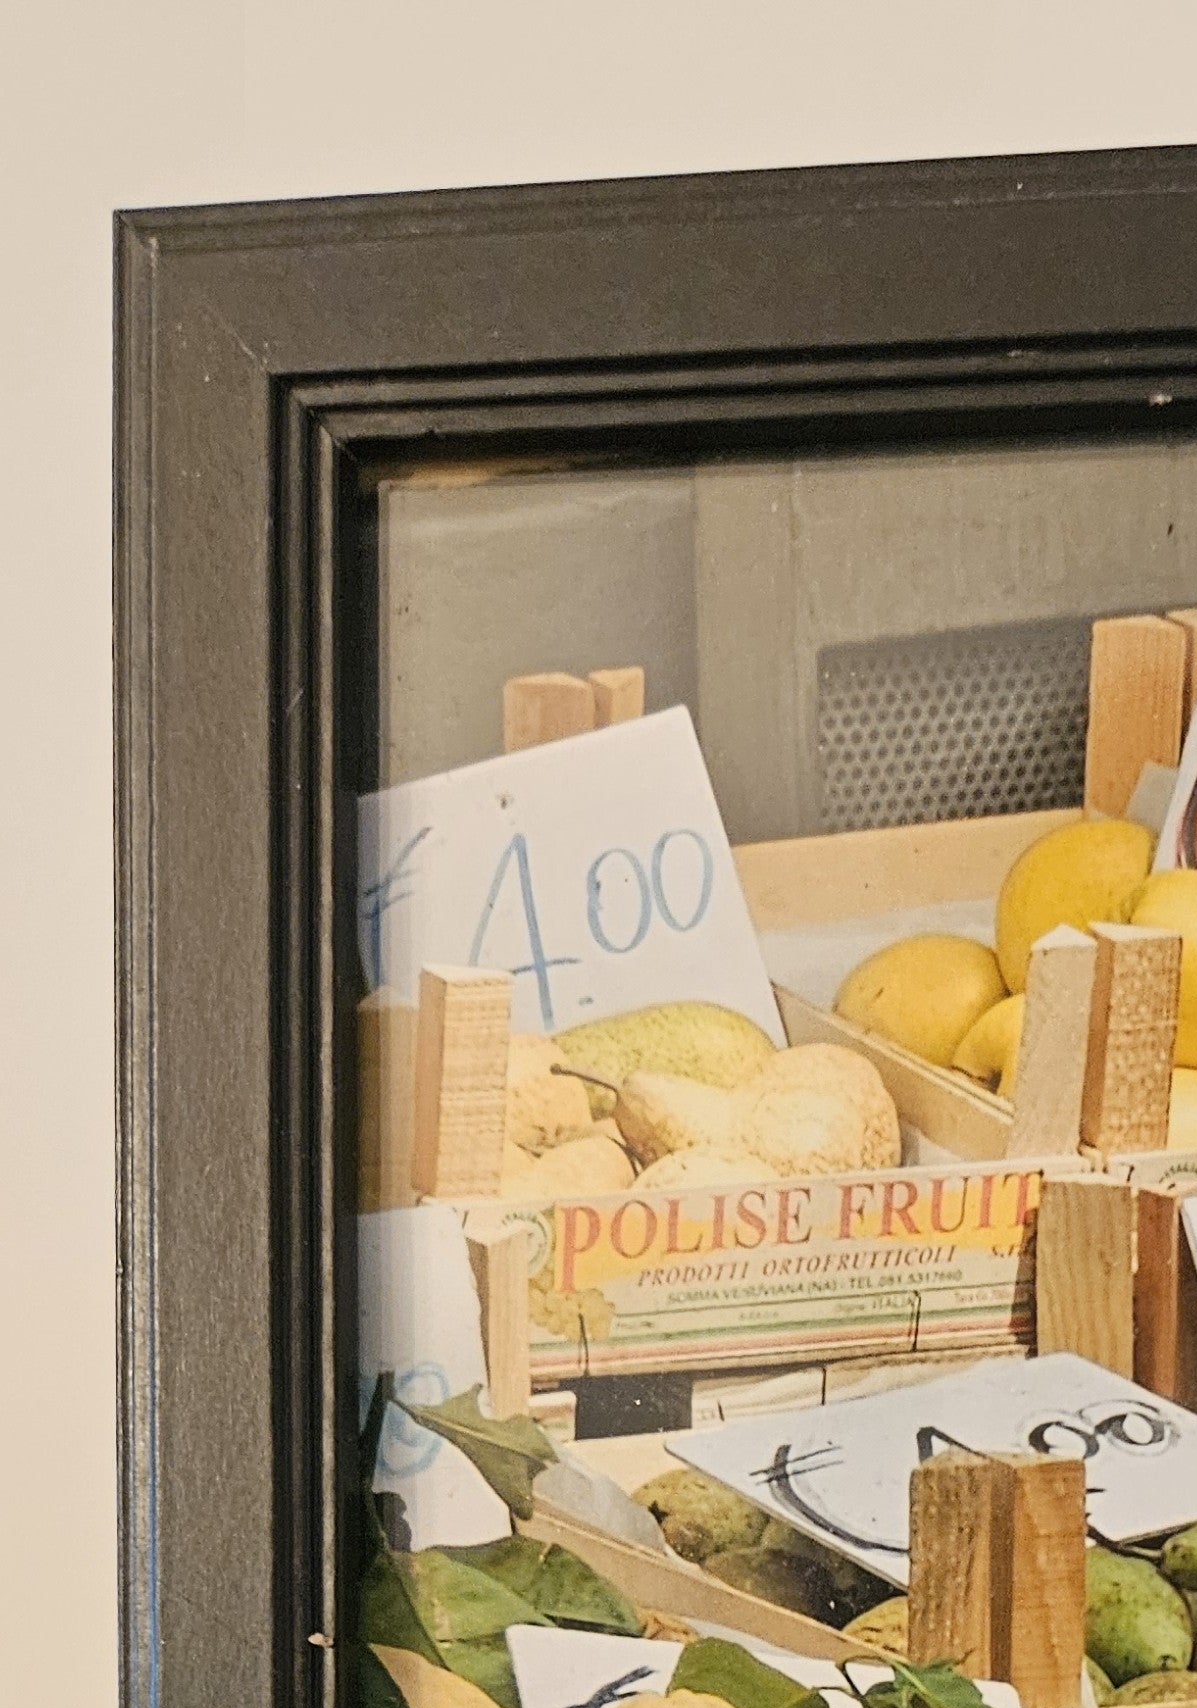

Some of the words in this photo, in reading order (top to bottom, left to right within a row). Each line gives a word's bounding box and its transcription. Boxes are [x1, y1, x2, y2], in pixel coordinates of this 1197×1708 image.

[557, 1186, 812, 1294] POLISE
[836, 1170, 1043, 1240] FRUIT
[637, 1261, 749, 1288] PRODOTTI
[763, 1245, 957, 1278] ORTOFRUTTICOLI
